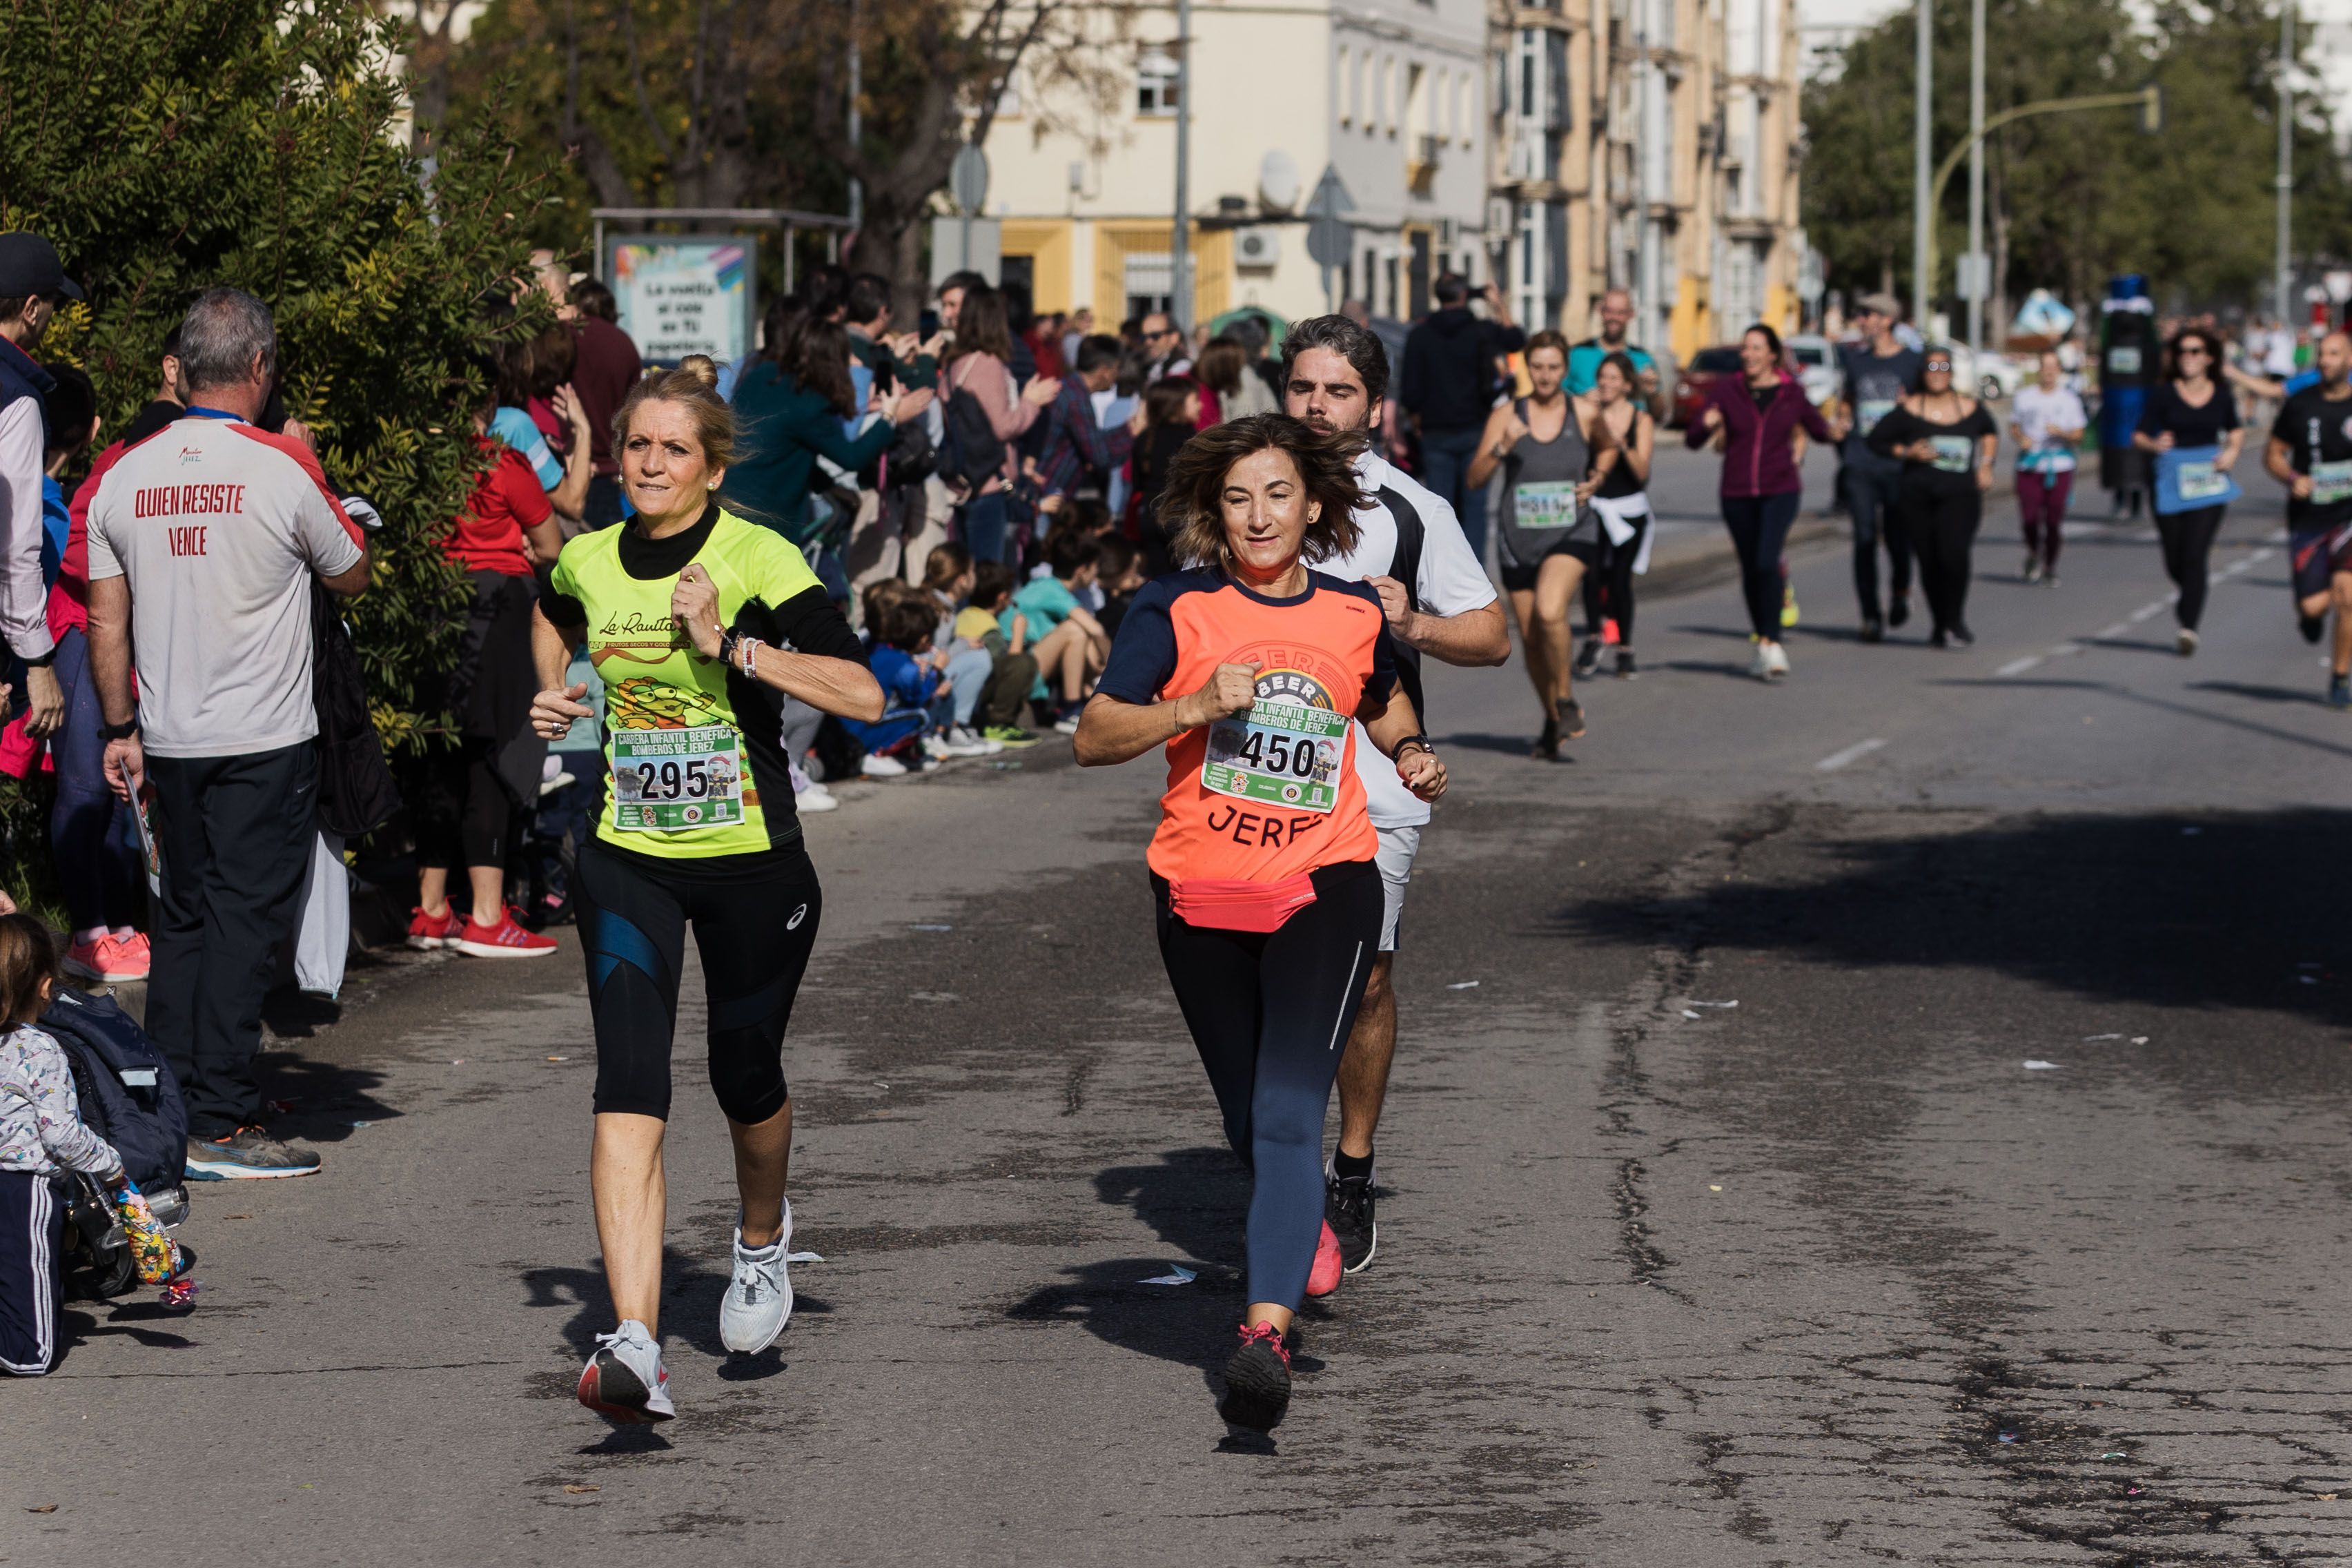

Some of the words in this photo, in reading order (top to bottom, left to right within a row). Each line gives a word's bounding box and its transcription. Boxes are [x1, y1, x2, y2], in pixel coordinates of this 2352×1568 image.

[135, 485, 180, 518] QUIEN
[182, 484, 245, 514] RESISTE
[168, 526, 207, 556] VENCE
[599, 610, 620, 636] La
[621, 612, 676, 635] Ranita
[1257, 675, 1317, 700] BEER
[1240, 709, 1289, 729] BOMBEROS
[1289, 718, 1302, 731] DE
[1303, 721, 1328, 735] JEREZ
[1266, 703, 1306, 720] INFANTIL
[618, 733, 649, 745] CARRERA
[650, 732, 687, 744] INFANTIL
[631, 744, 674, 756] BOMBEROS
[674, 743, 687, 754] DE
[689, 741, 715, 753] JEREZ
[1239, 731, 1315, 778] 450
[638, 760, 708, 799] 295
[1208, 805, 1323, 848] JERE
